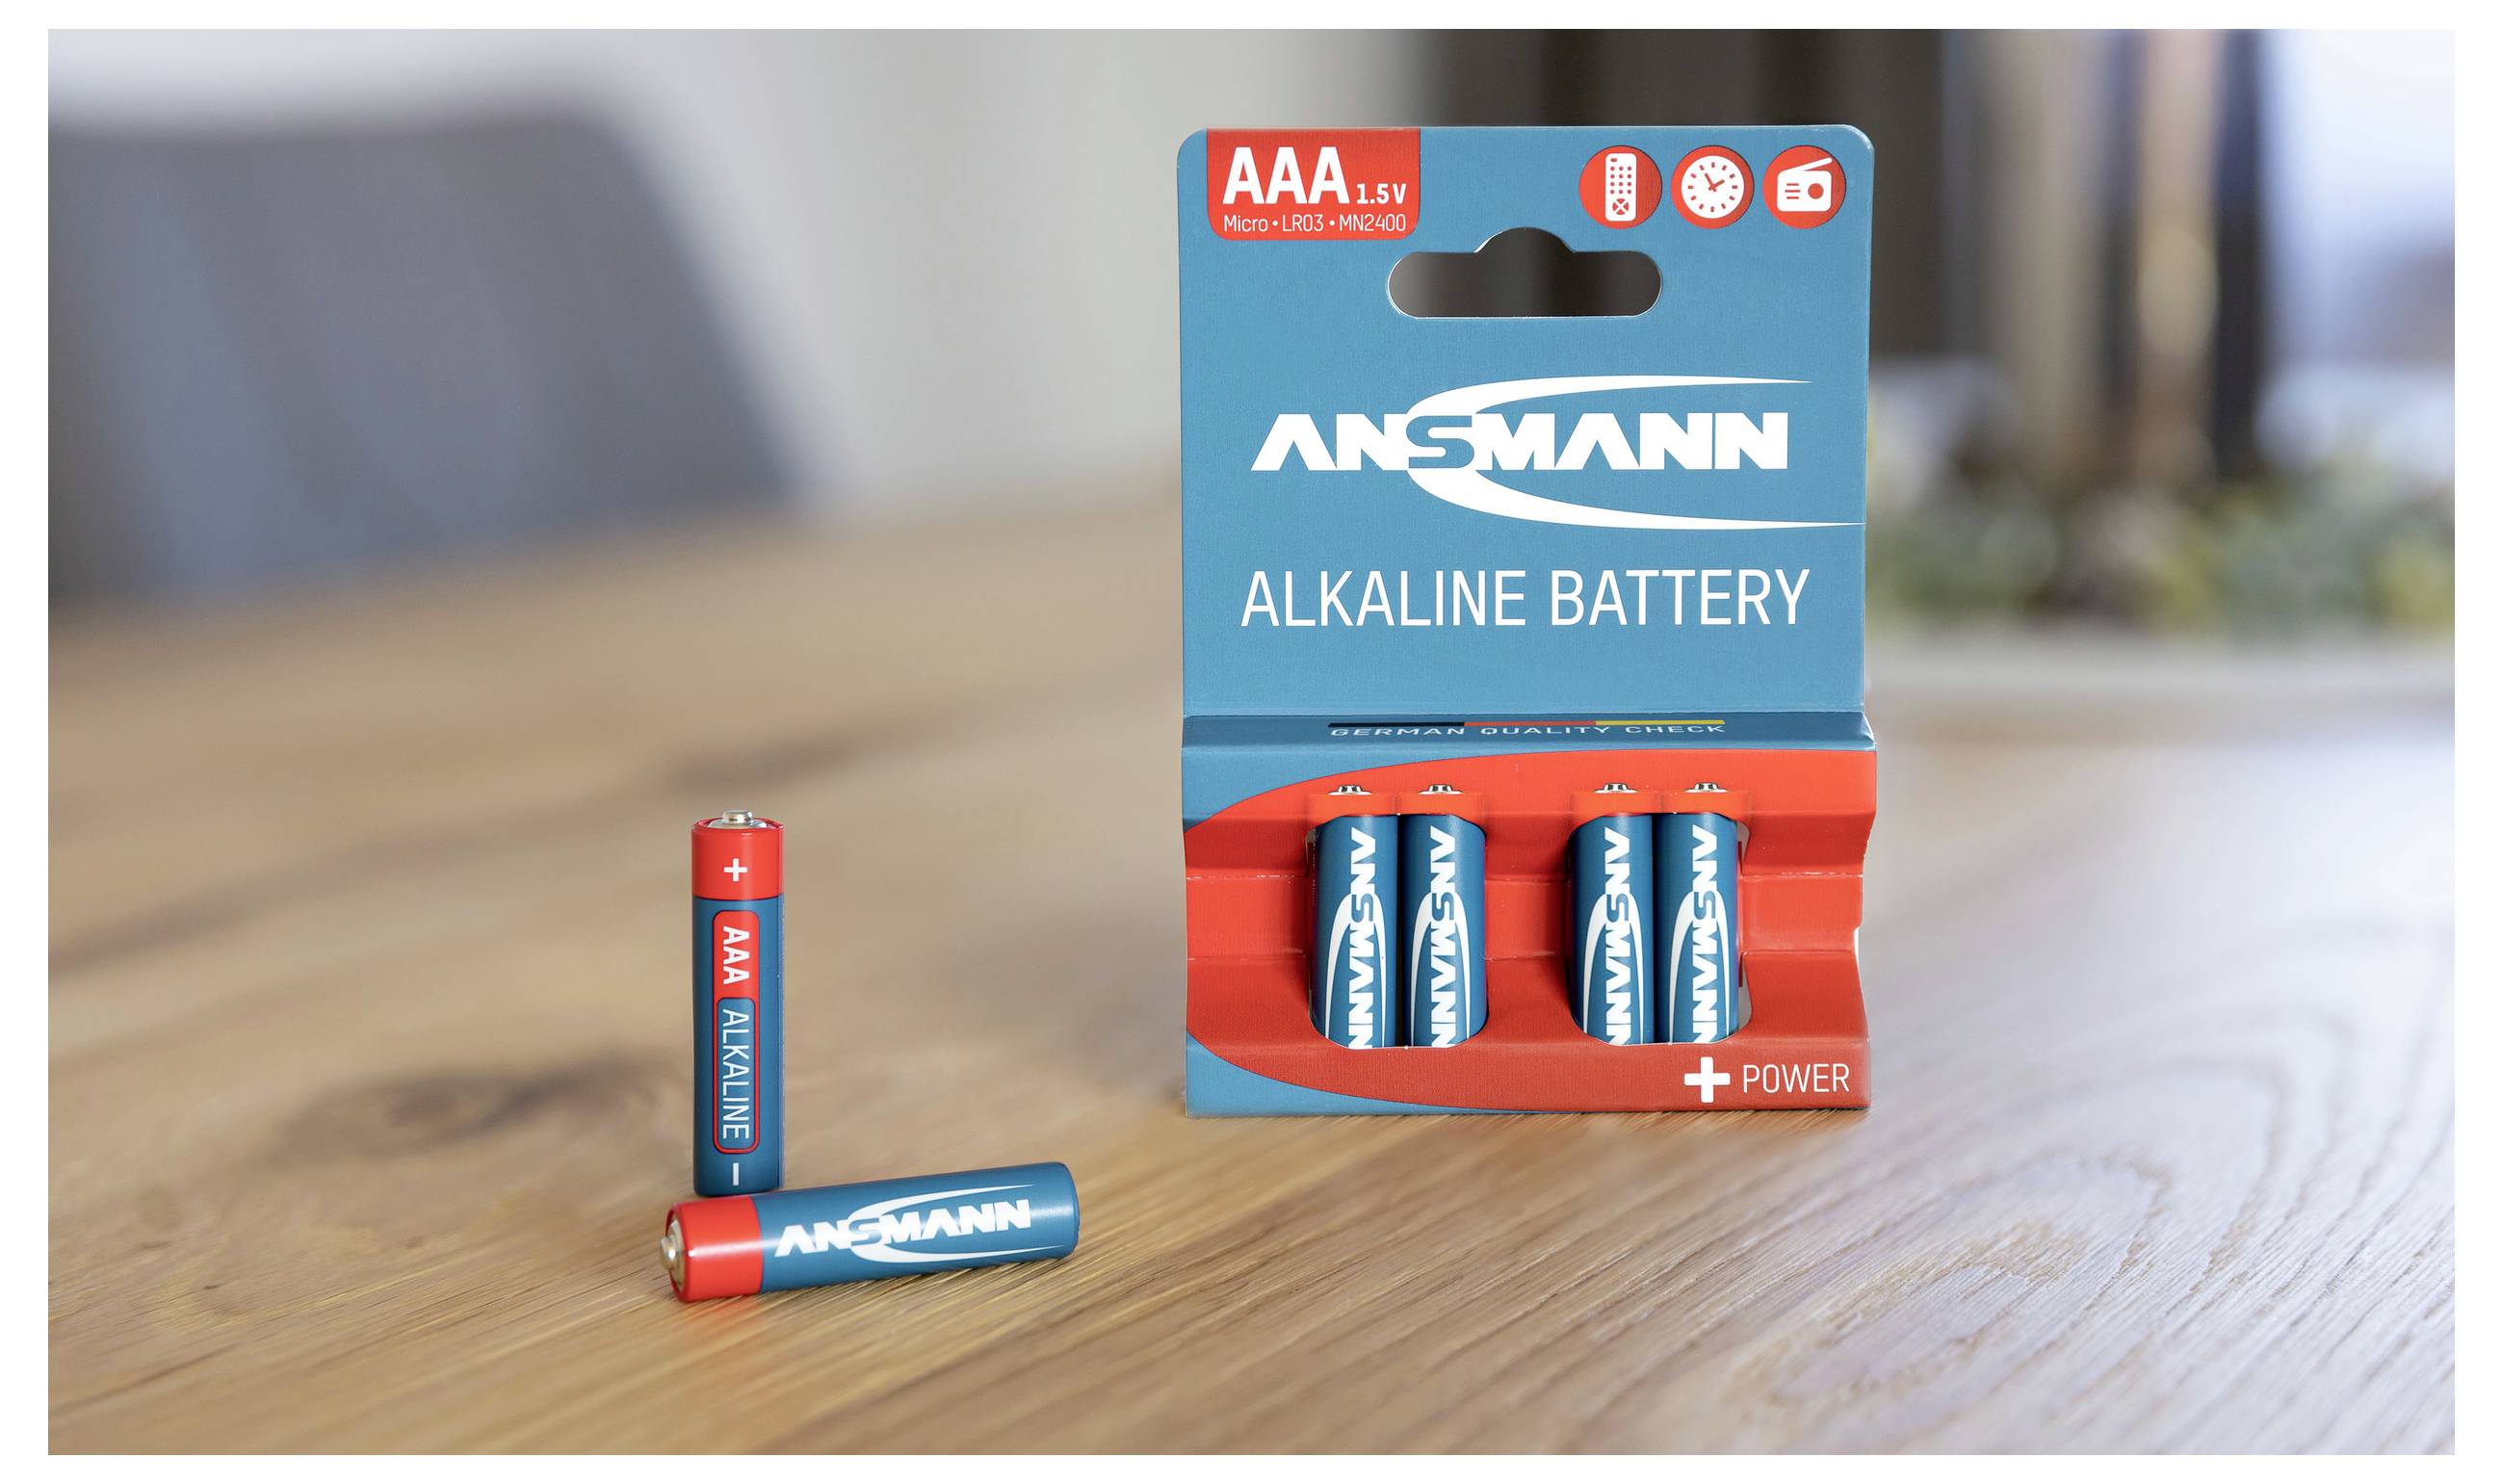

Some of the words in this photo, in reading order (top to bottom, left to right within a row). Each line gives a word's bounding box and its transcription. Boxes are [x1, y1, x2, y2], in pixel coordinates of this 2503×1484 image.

[1222, 146, 1350, 204] AAA
[1224, 215, 1268, 232] Micro
[1282, 214, 1324, 232] LR03
[1339, 213, 1406, 232] MN2400
[1251, 412, 1789, 472] ANSMANN
[1240, 569, 1526, 627] ALKALINE
[1551, 568, 1811, 626] BATTERY
[1330, 727, 1465, 737] GERMAN
[1480, 726, 1610, 736] QUALITY
[1625, 725, 1726, 734] CHECK
[722, 925, 750, 985] AAA
[722, 1008, 750, 1140] ALKALINE
[1742, 1062, 1850, 1094] POWER
[774, 1199, 1031, 1257] ANSMANN
